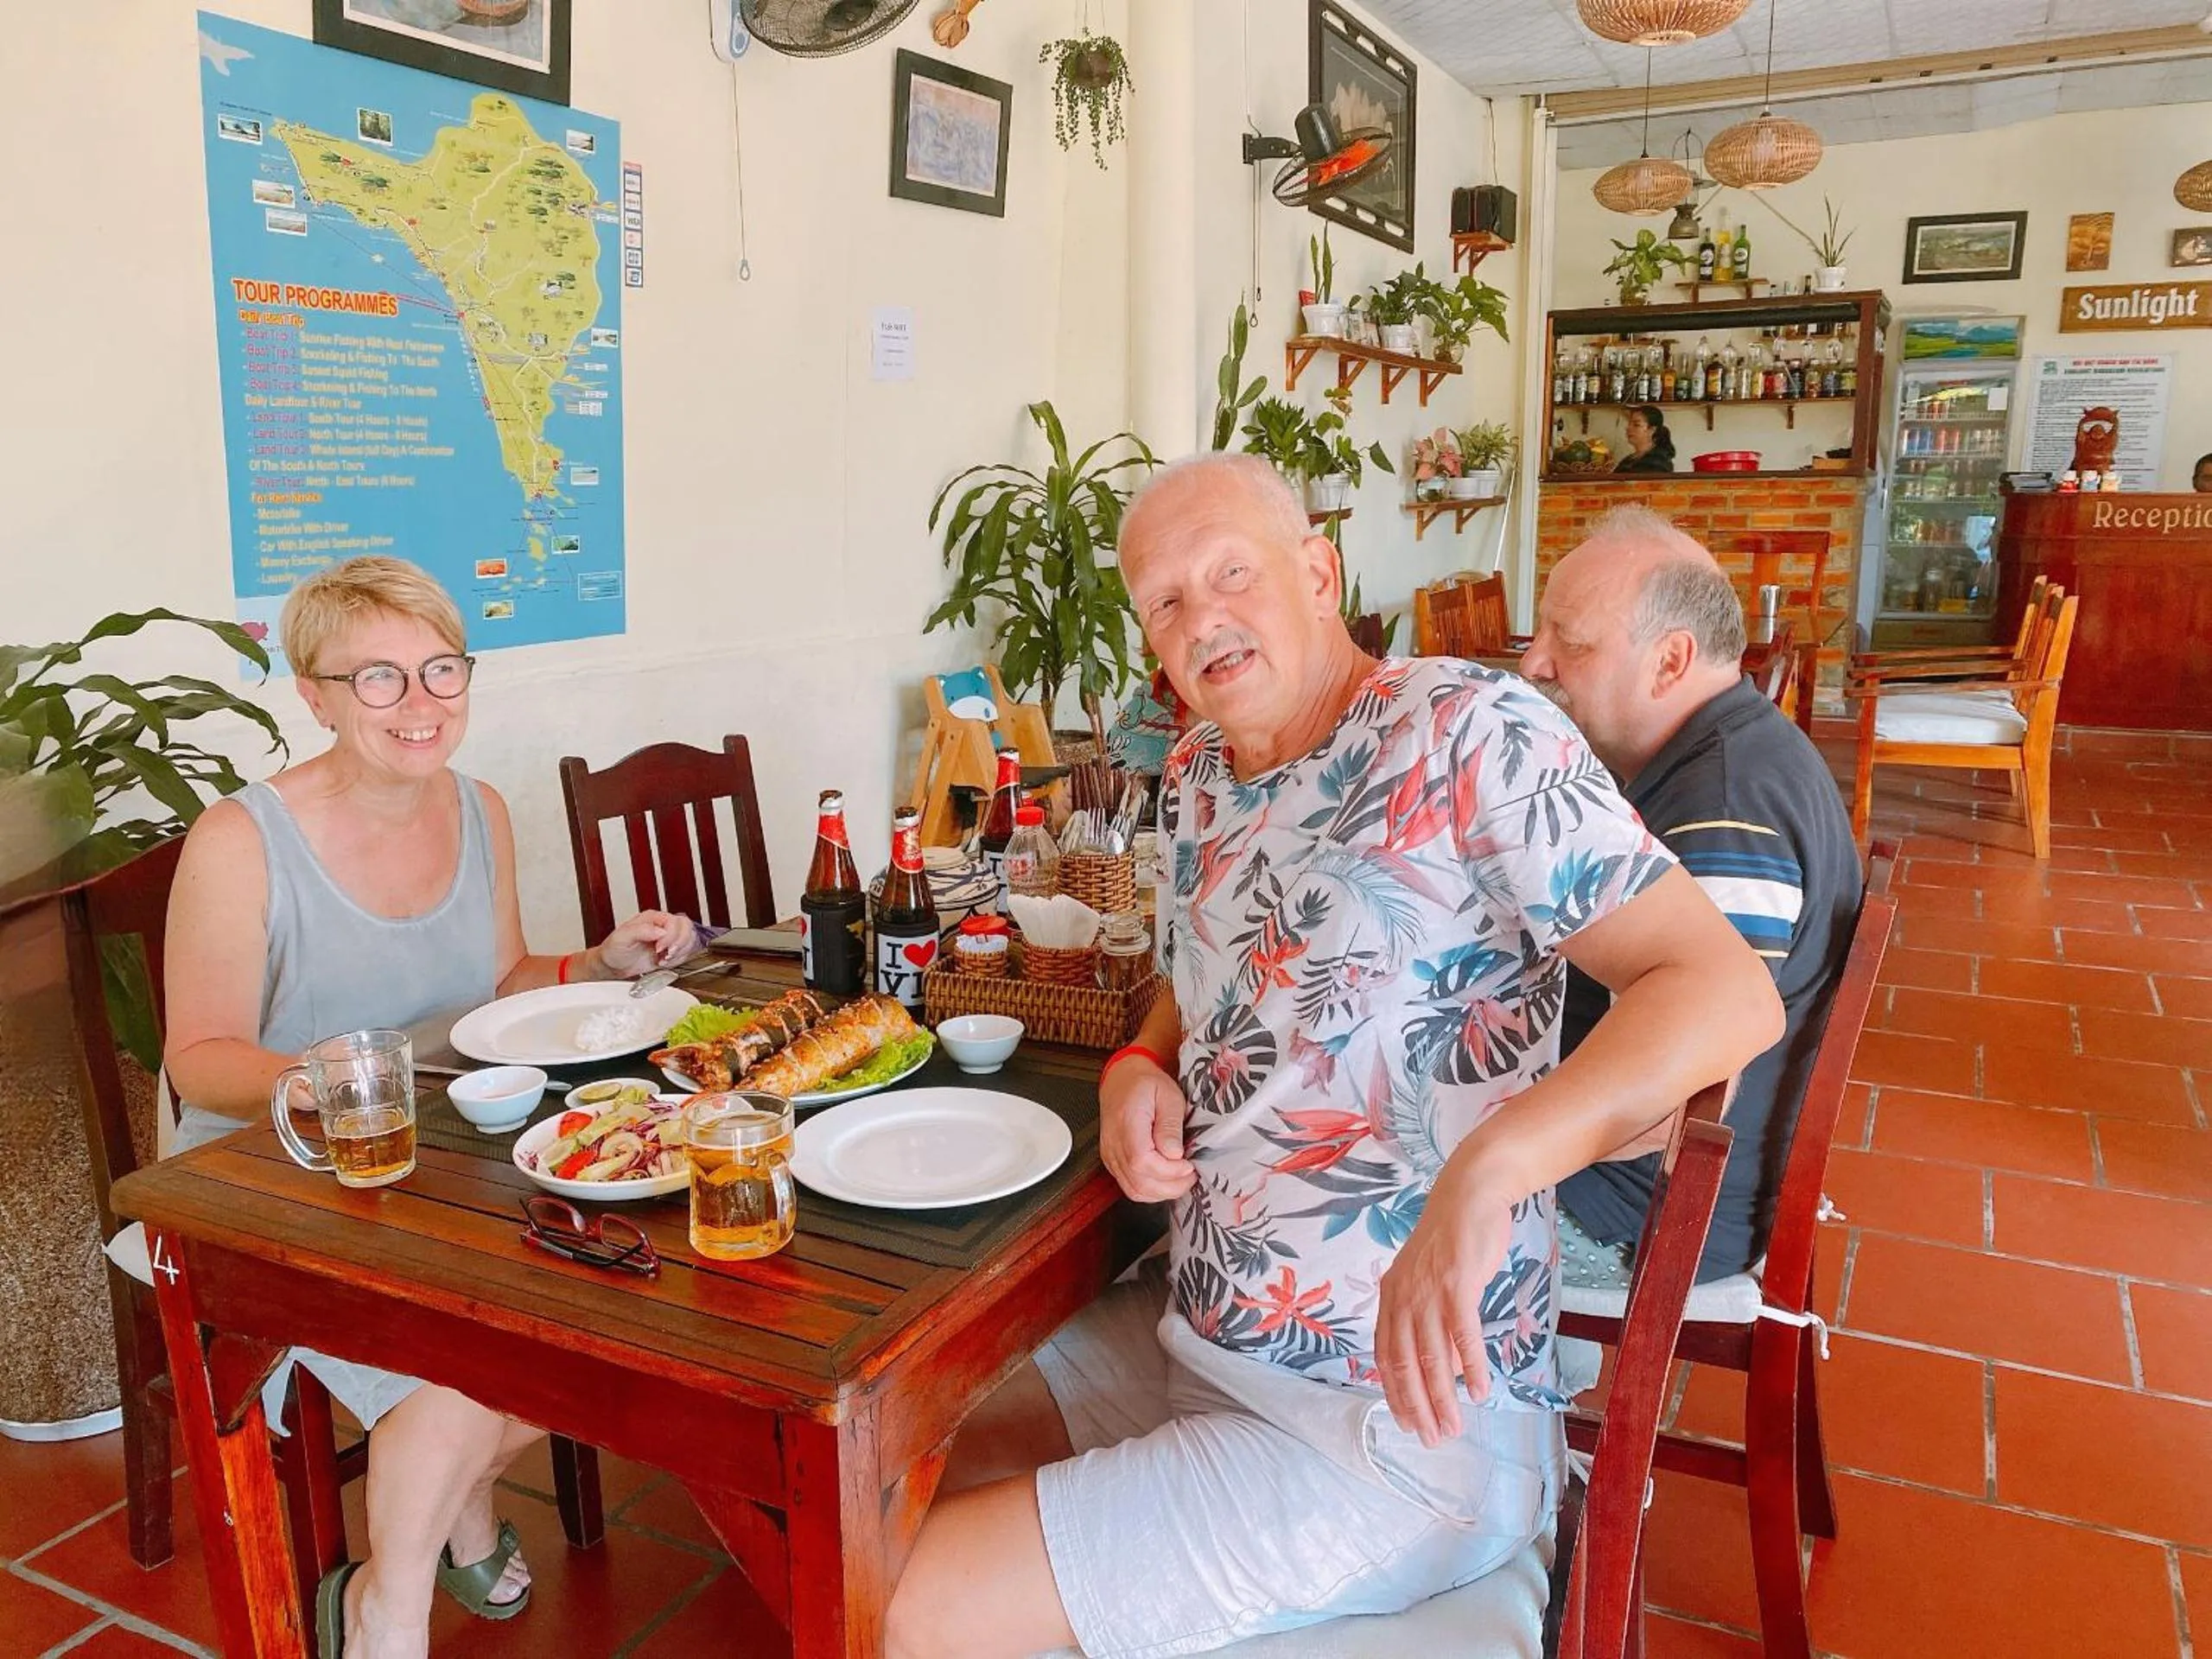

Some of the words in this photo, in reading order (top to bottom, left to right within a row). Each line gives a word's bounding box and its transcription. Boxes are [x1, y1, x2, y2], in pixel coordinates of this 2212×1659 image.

[232, 279, 281, 305] TOUR
[285, 284, 398, 316] PROGRAMMES
[2077, 287, 2199, 324] Sunlight
[885, 942, 903, 969] I
[153, 1235, 180, 1286] 4
